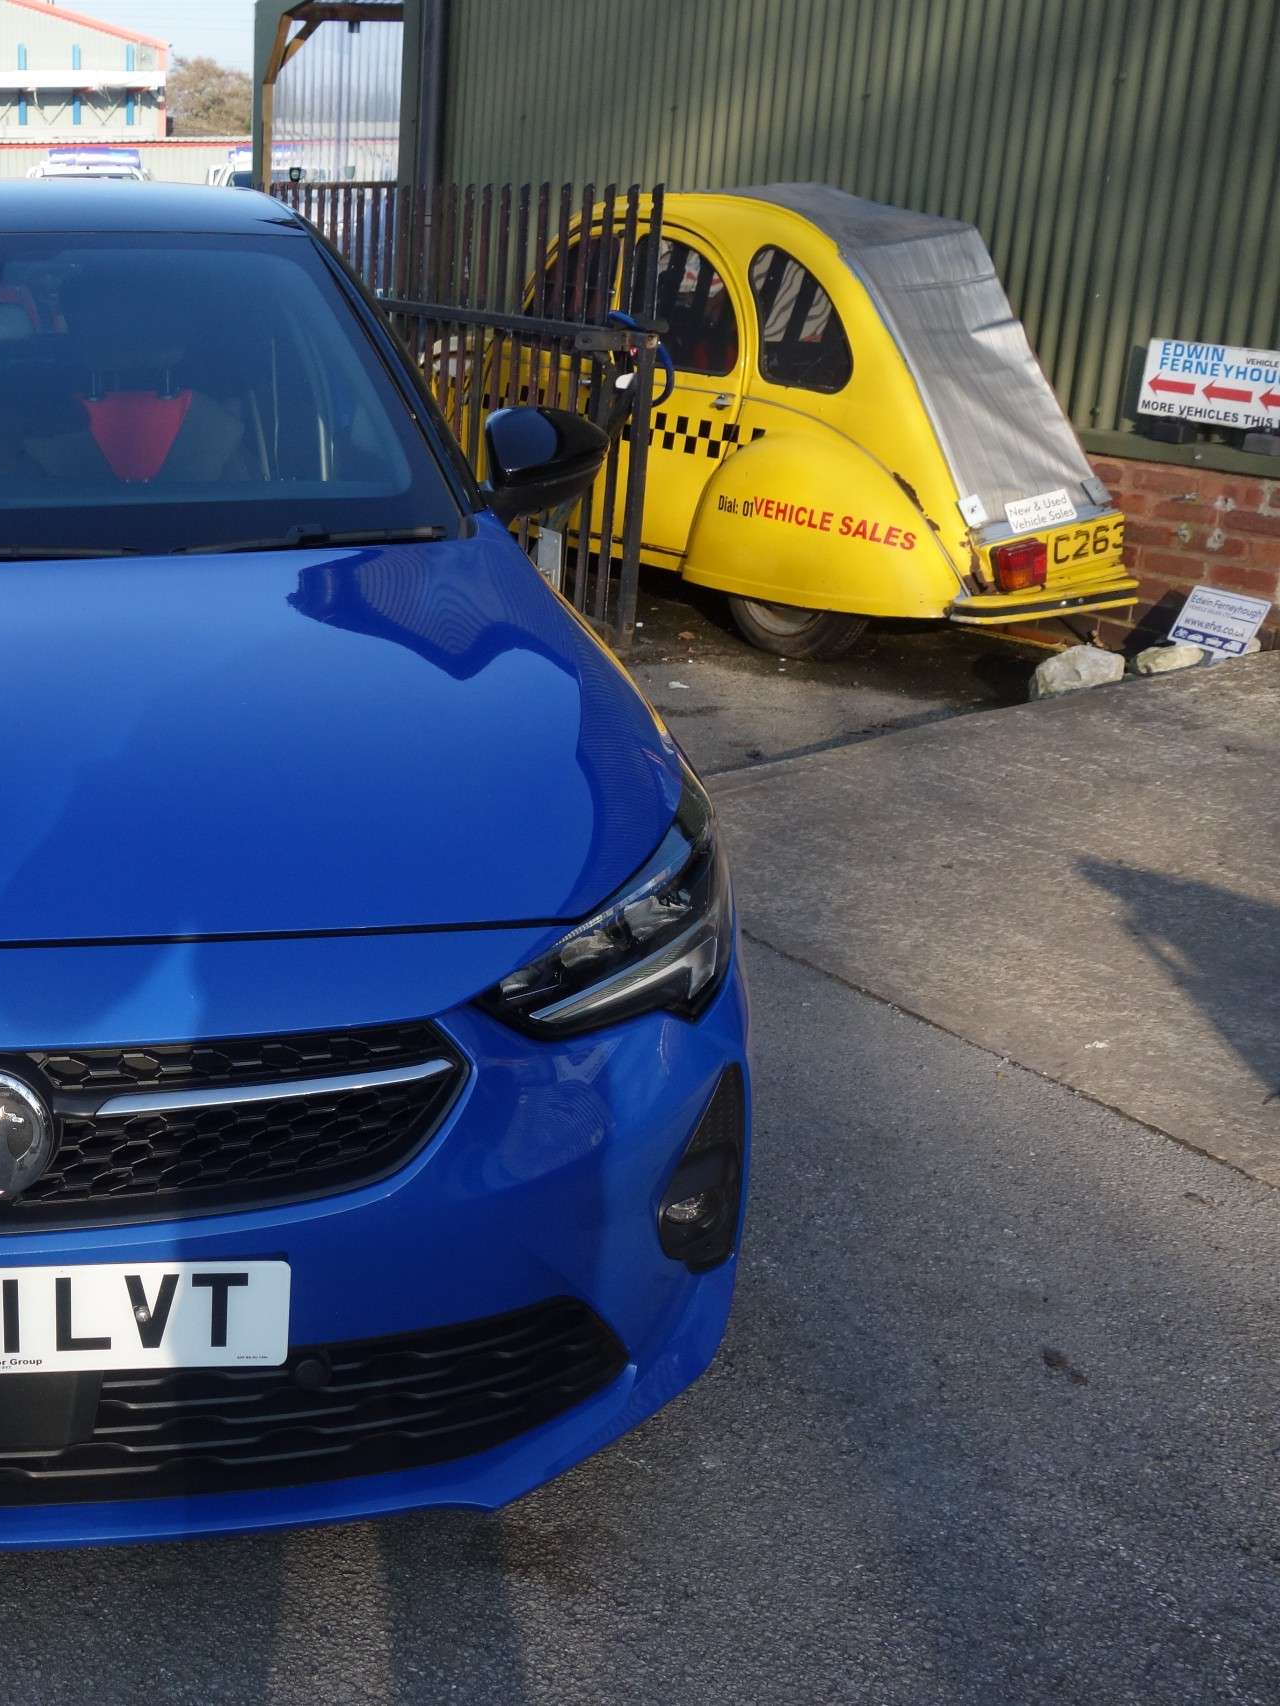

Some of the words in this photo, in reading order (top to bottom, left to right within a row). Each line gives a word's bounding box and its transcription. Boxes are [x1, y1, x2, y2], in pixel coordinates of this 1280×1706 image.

[1162, 342, 1225, 362] EDWIN
[1246, 357, 1280, 368] VEHICLE
[1159, 357, 1280, 384] FERNEYHOU
[1141, 400, 1175, 413] MORE
[1178, 405, 1239, 422] VEHICLES
[1243, 414, 1273, 429] THIS
[718, 495, 738, 514] Dial:
[1009, 506, 1031, 518] New
[1033, 503, 1041, 511] &
[1045, 495, 1068, 509] Used
[753, 496, 835, 532] VEHICLE
[838, 516, 918, 551] SALES
[1012, 514, 1049, 531] Vehicle
[1049, 508, 1074, 521] Sales
[55, 1272, 249, 1352] LVT
[9, 1358, 43, 1367] Group
